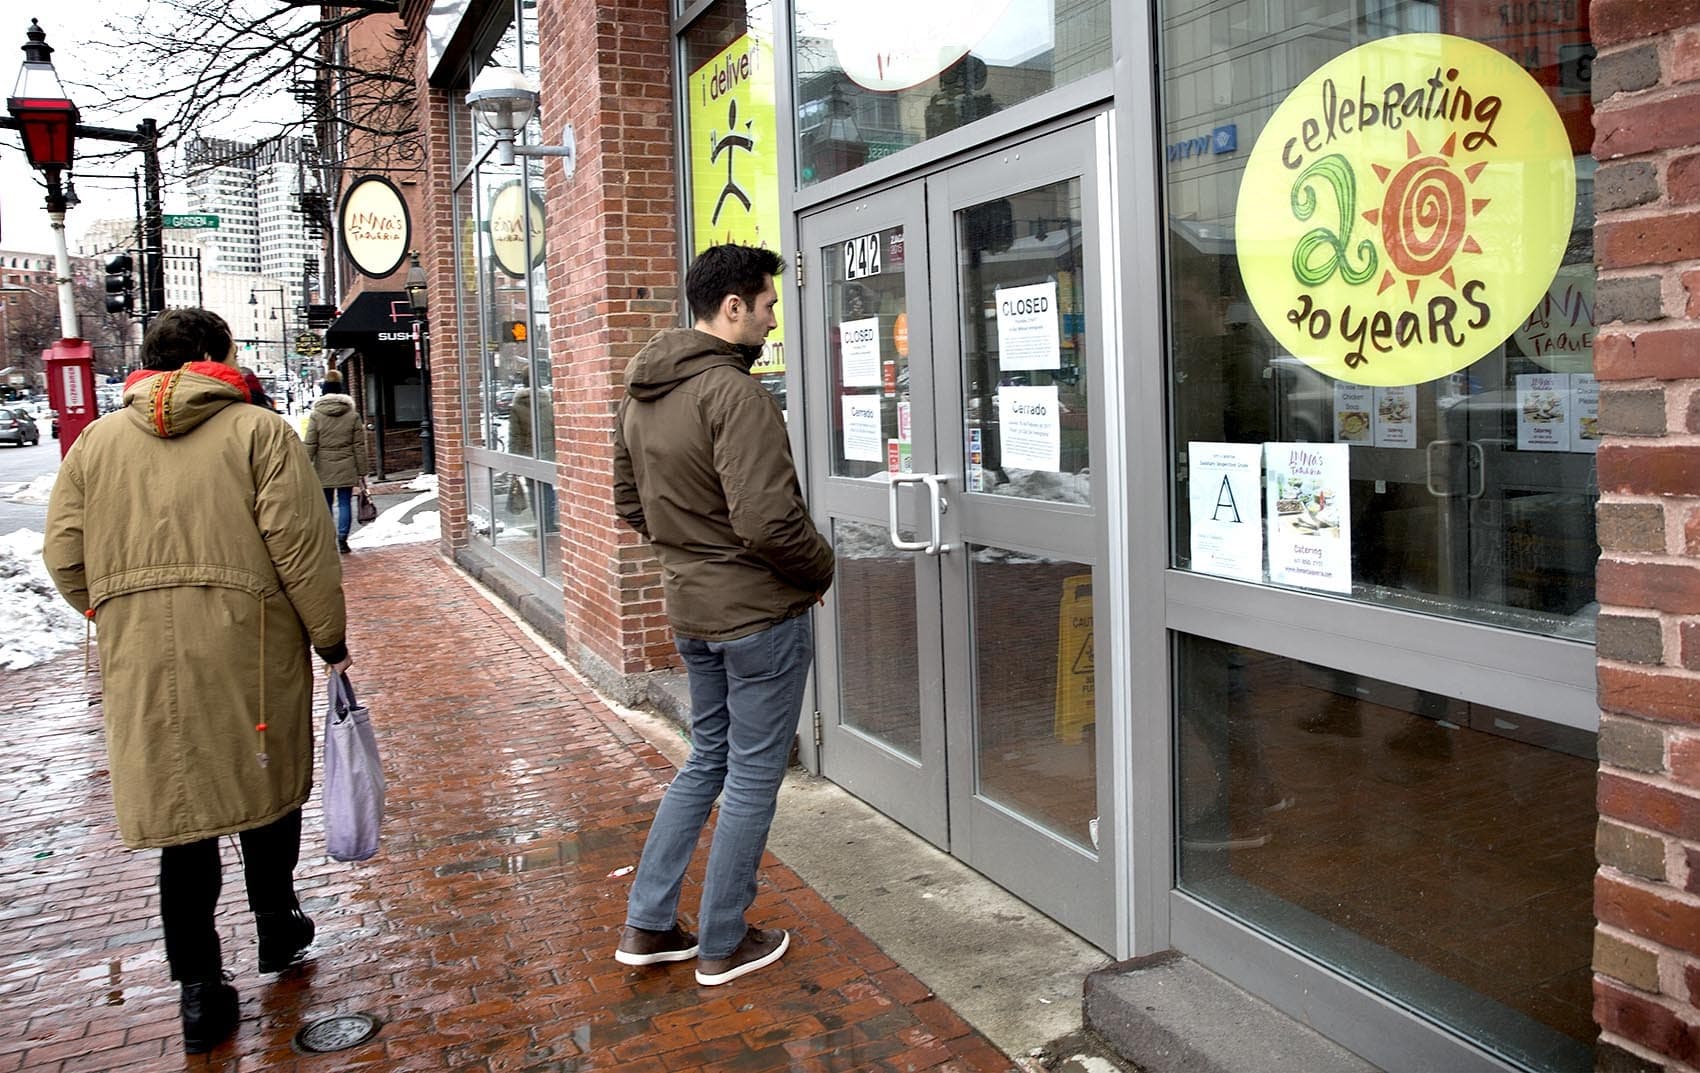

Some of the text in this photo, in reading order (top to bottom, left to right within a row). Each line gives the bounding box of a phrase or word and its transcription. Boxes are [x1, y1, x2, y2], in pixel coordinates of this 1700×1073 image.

[847, 234, 879, 279] 242
[1002, 296, 1049, 316] CLOSED
[1287, 294, 1331, 339] 20
[378, 332, 417, 341] SUSH
[844, 328, 873, 344] CLOSED
[1012, 401, 1047, 416] Cerrado
[1211, 474, 1244, 523] A
[1294, 545, 1323, 560] Catering
